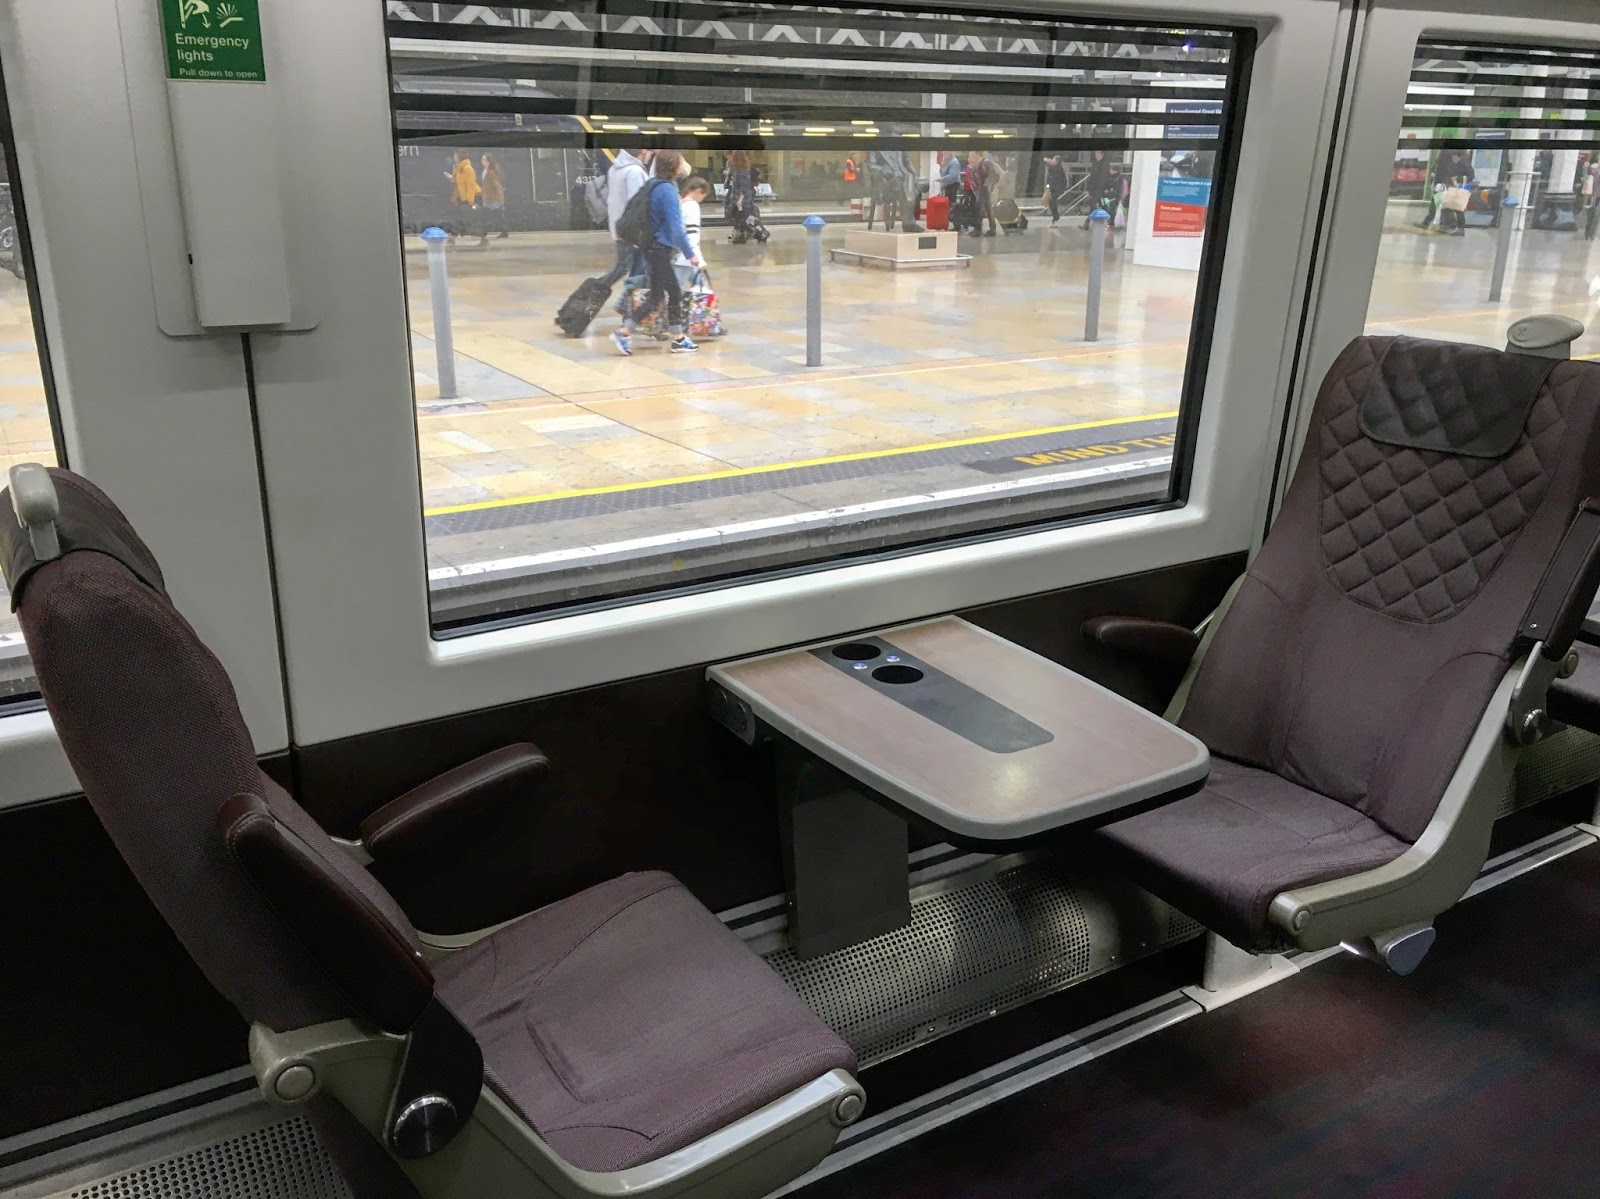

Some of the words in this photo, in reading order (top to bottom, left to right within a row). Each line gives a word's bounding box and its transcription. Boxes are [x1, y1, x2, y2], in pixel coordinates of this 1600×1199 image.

[175, 33, 249, 49] Emergency
[177, 49, 214, 63] lights
[179, 68, 196, 76] Pull
[198, 68, 222, 77] down
[225, 69, 234, 78] to
[236, 71, 258, 79] open
[1013, 445, 1129, 466] MIND
[1119, 433, 1176, 448] TH
